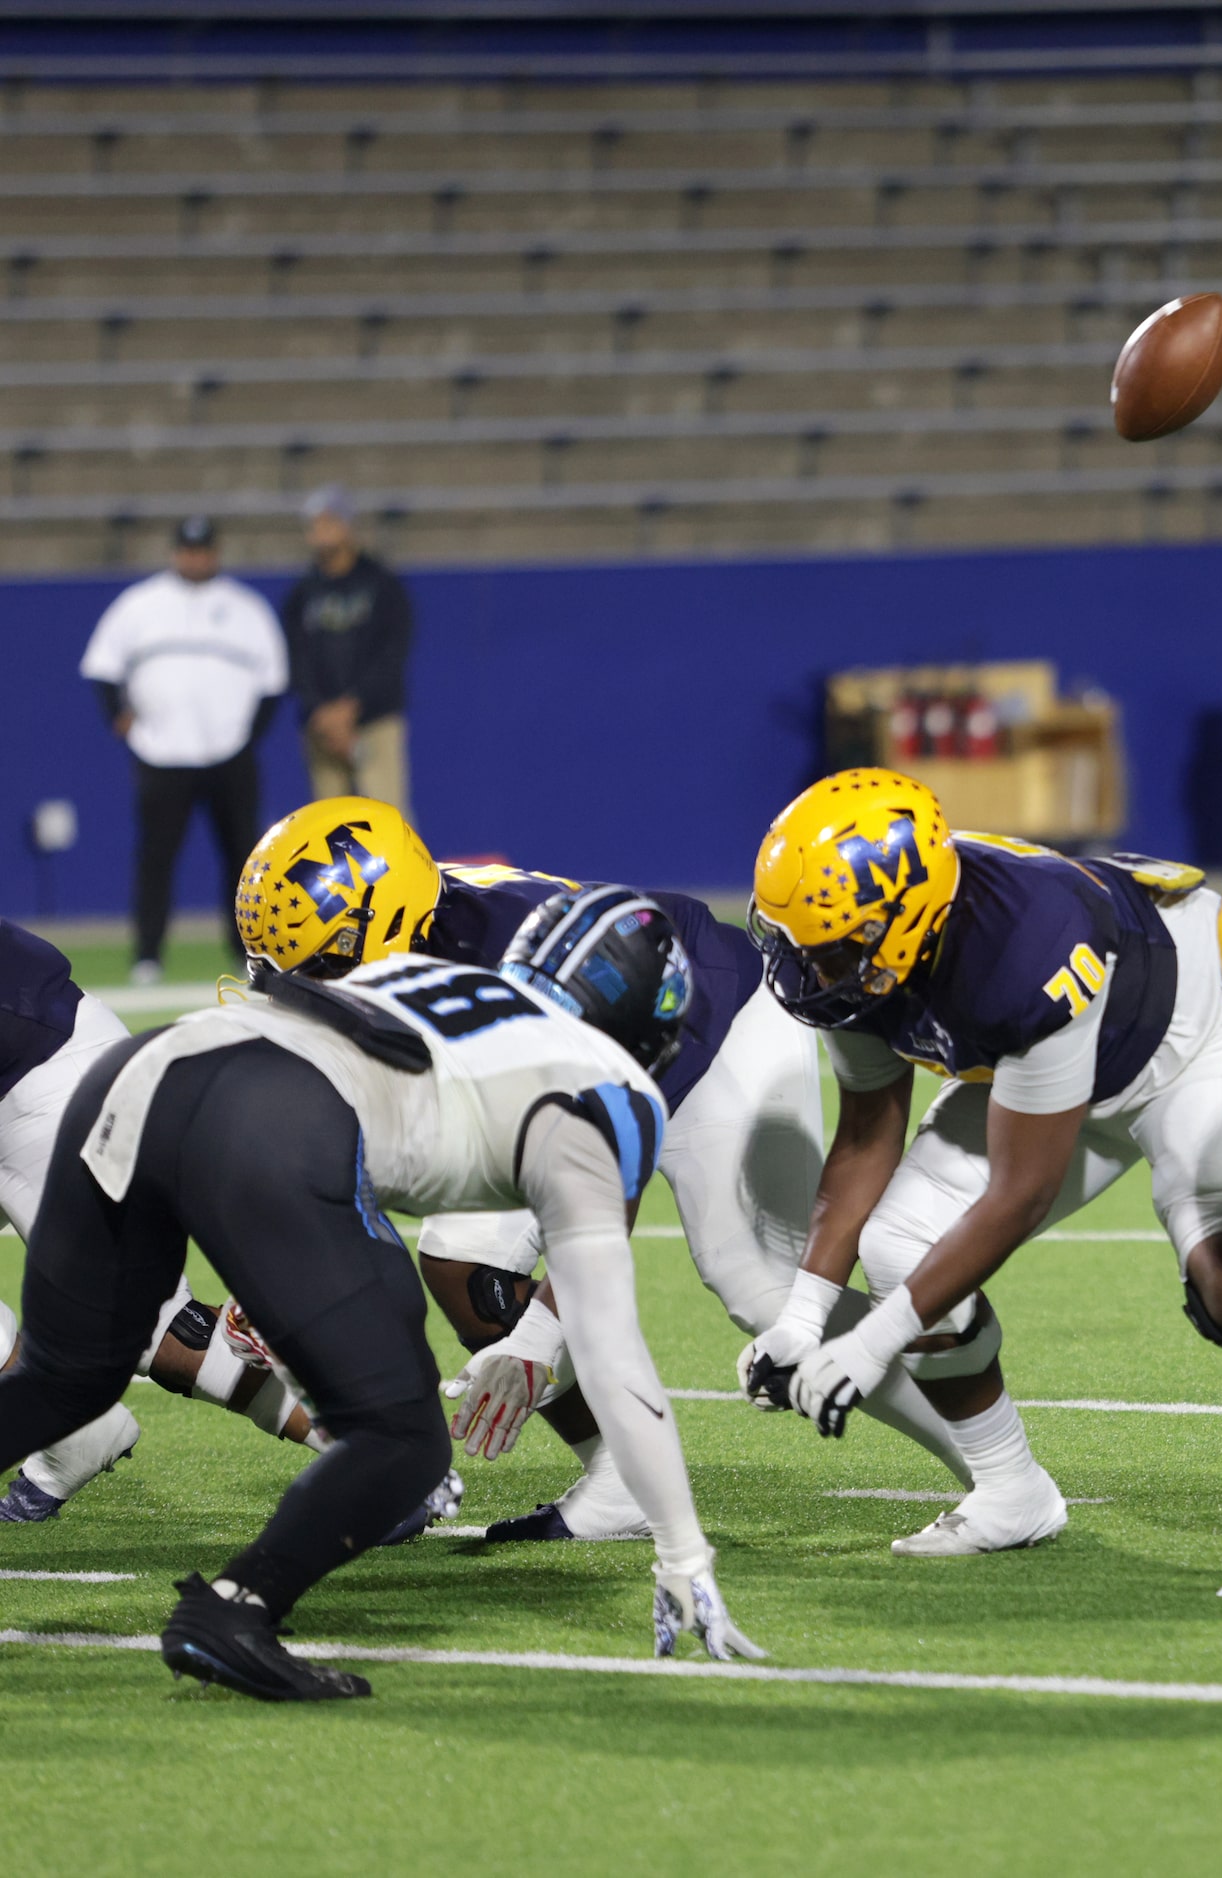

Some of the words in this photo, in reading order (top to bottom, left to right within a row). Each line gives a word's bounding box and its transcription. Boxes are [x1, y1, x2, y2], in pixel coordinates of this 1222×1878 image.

[284, 824, 390, 924] M
[836, 817, 929, 908] M
[1042, 942, 1106, 1018] 70
